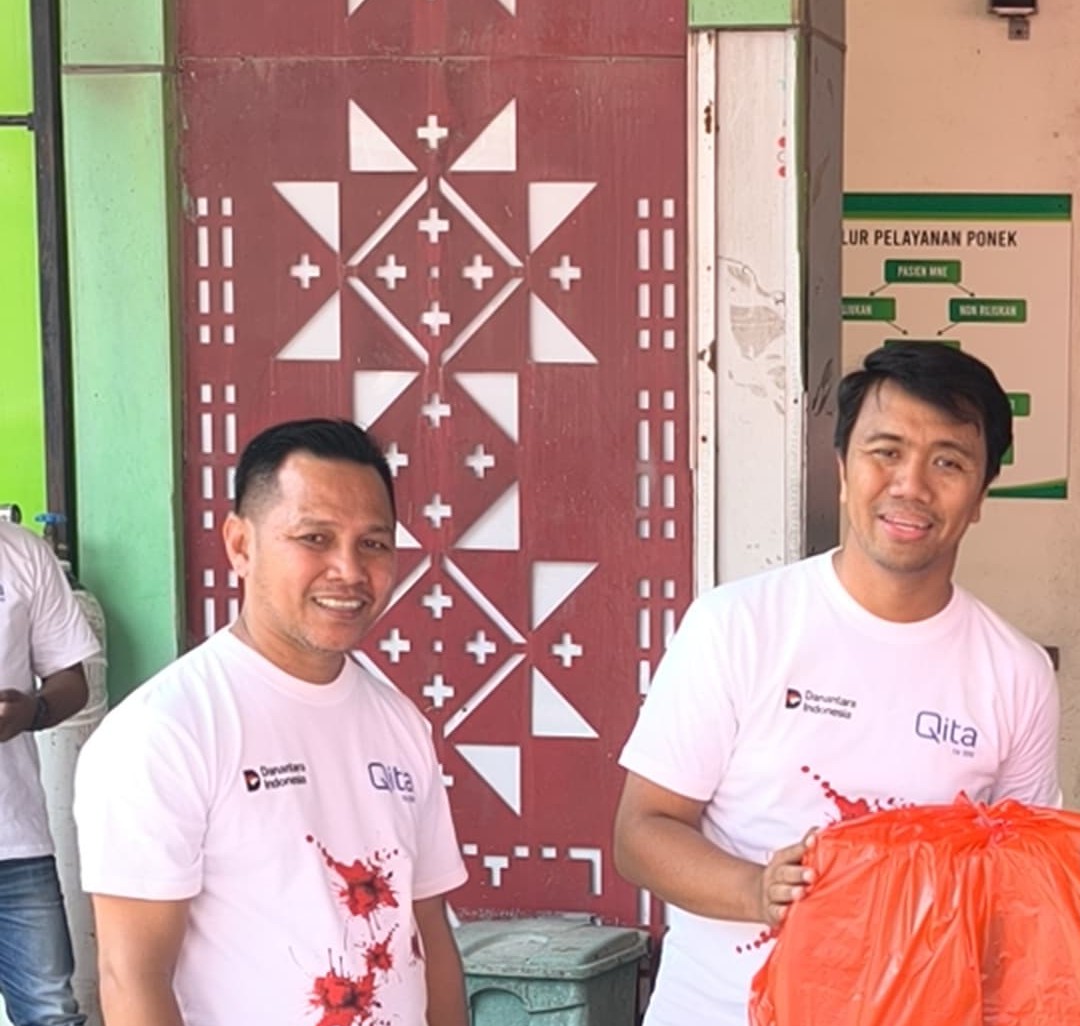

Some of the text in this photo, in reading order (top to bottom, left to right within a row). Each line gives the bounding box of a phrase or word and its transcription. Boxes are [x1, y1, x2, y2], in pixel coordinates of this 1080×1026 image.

[841, 229, 1017, 247] LUR PELAYANAN PONEK
[915, 711, 978, 748] Qita
[368, 762, 414, 792] Qita
